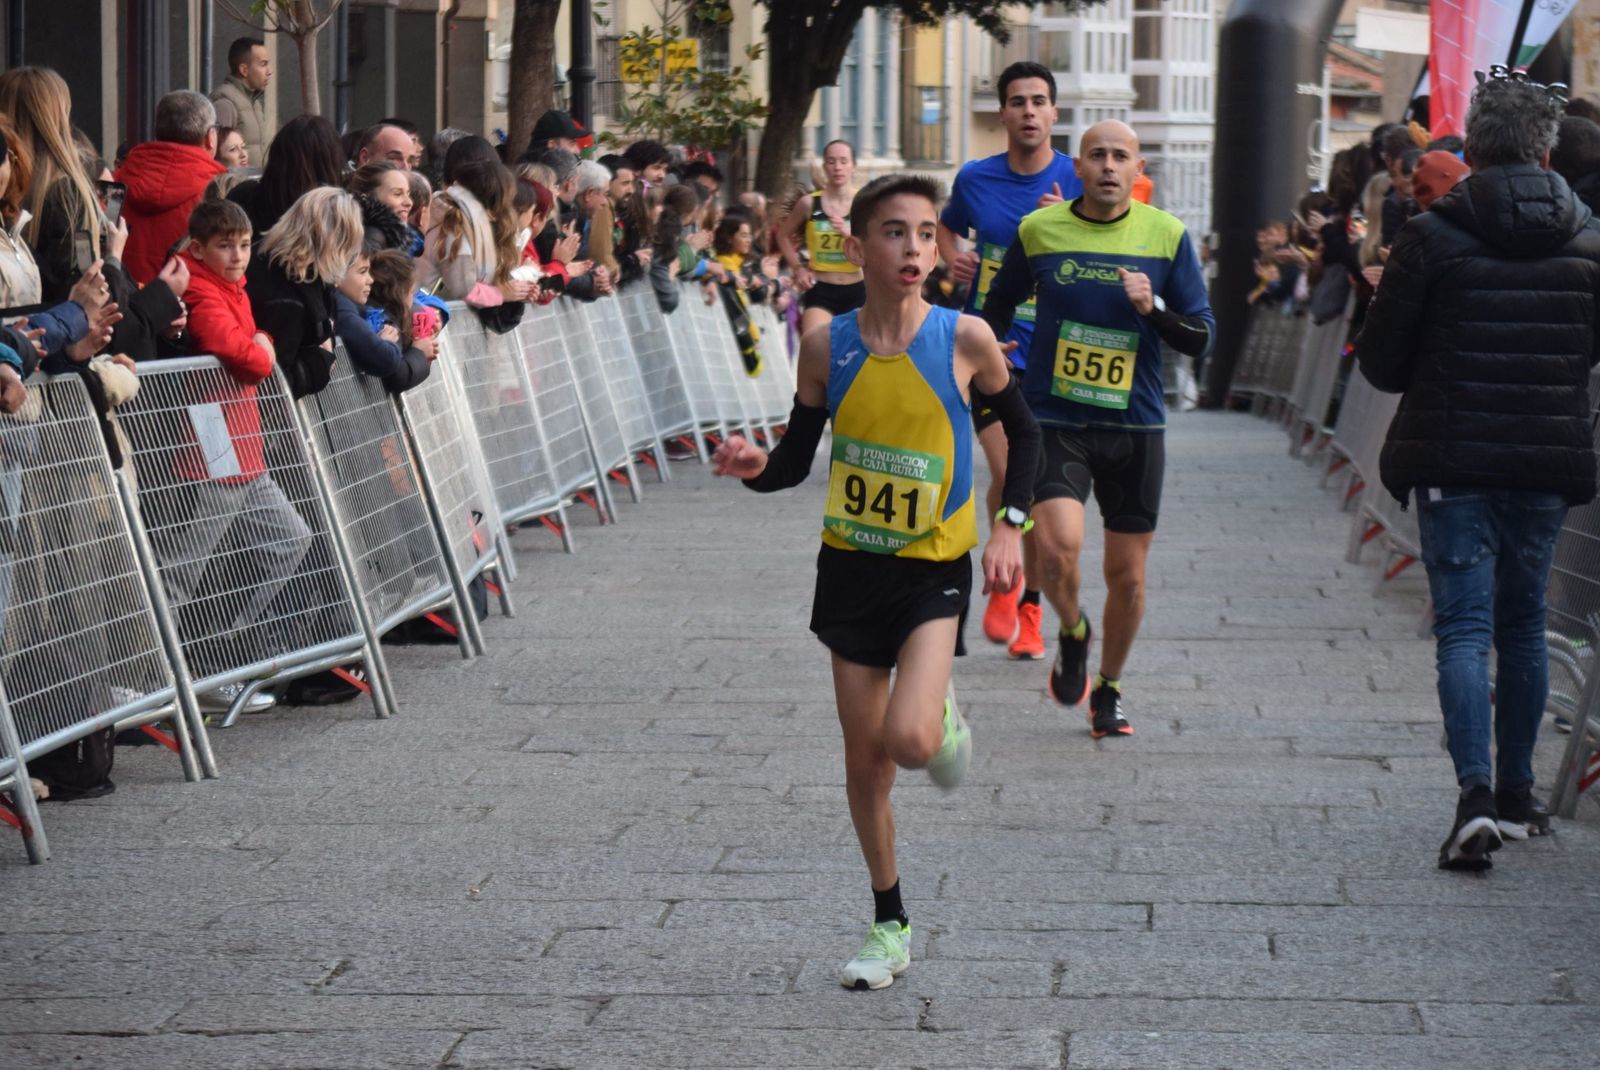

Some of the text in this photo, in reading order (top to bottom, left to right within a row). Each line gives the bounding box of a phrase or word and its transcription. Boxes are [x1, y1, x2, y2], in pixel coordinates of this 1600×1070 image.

[1062, 347, 1125, 385] 556
[862, 459, 888, 472] CAJA
[890, 463, 927, 480] RURAL
[863, 447, 929, 470] FUNDACION
[844, 474, 919, 529] 941
[855, 530, 885, 546] CAJA
